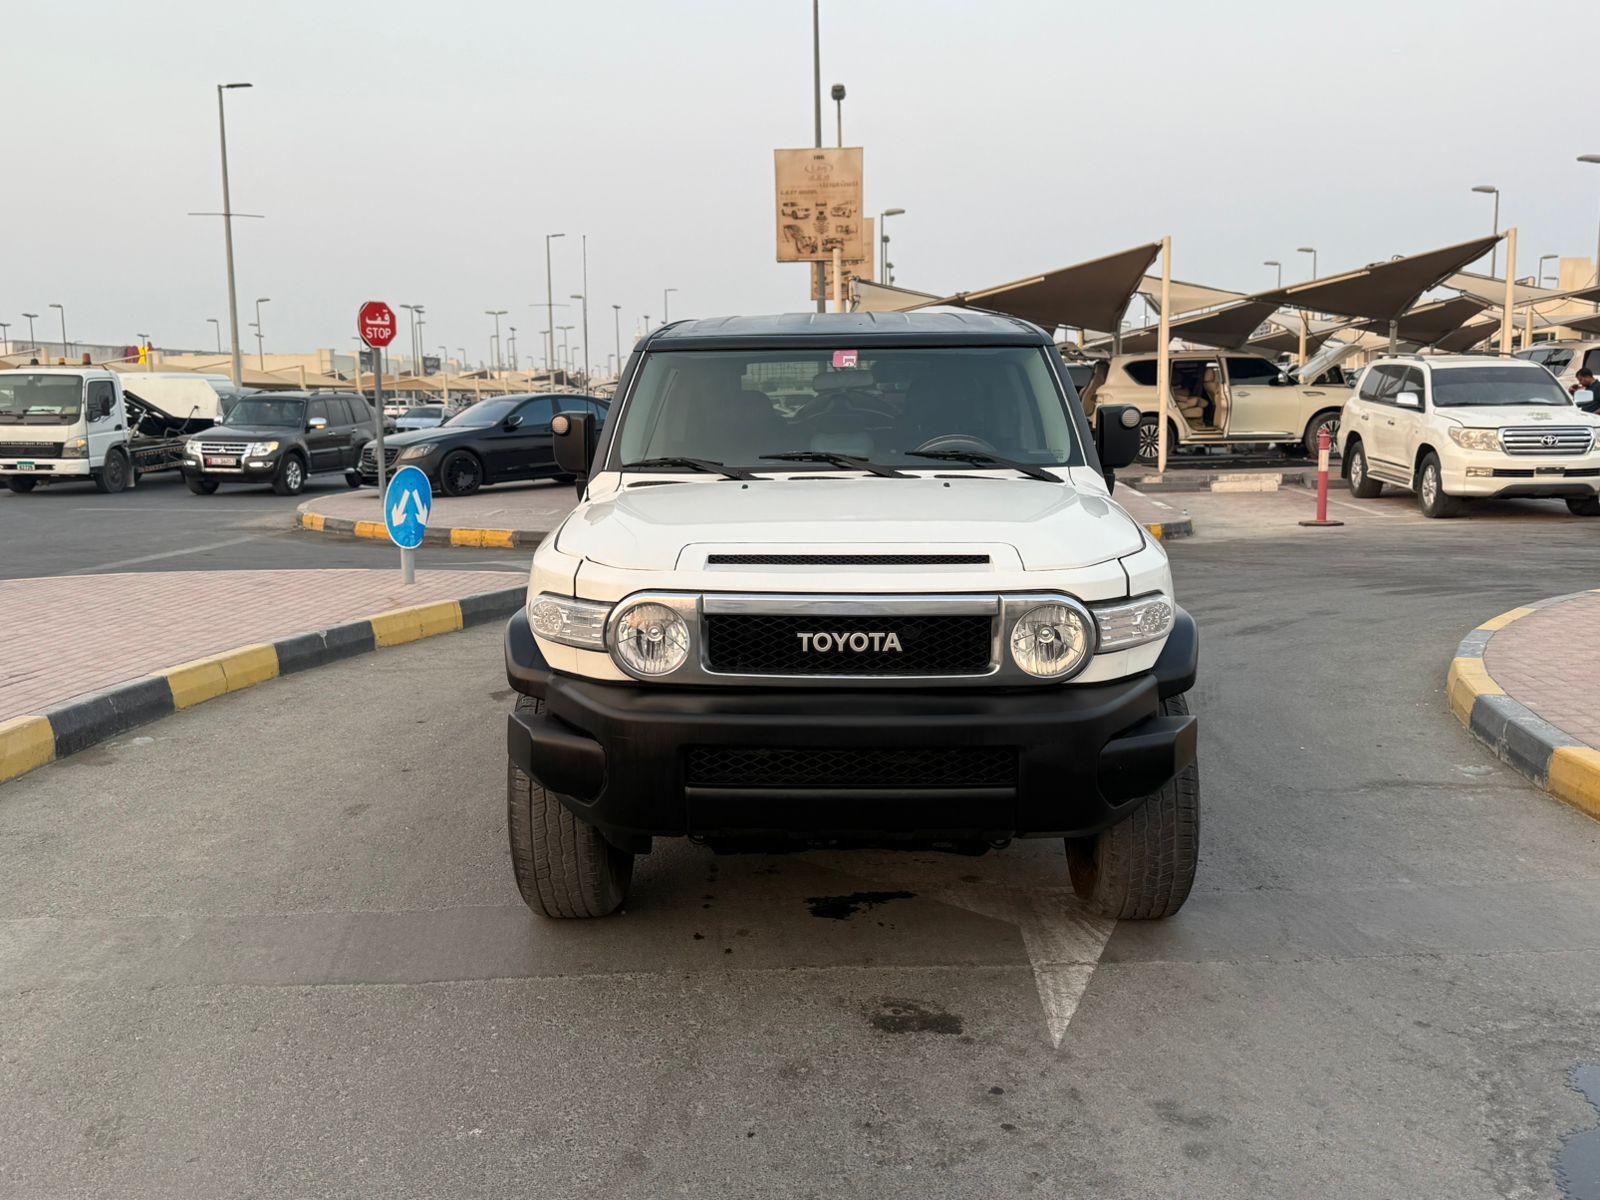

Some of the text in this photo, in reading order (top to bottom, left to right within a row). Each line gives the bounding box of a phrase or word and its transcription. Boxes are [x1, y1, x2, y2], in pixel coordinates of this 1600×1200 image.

[365, 309, 391, 325] قف
[366, 327, 392, 339] STOP
[796, 632, 903, 652] TOYOTA
